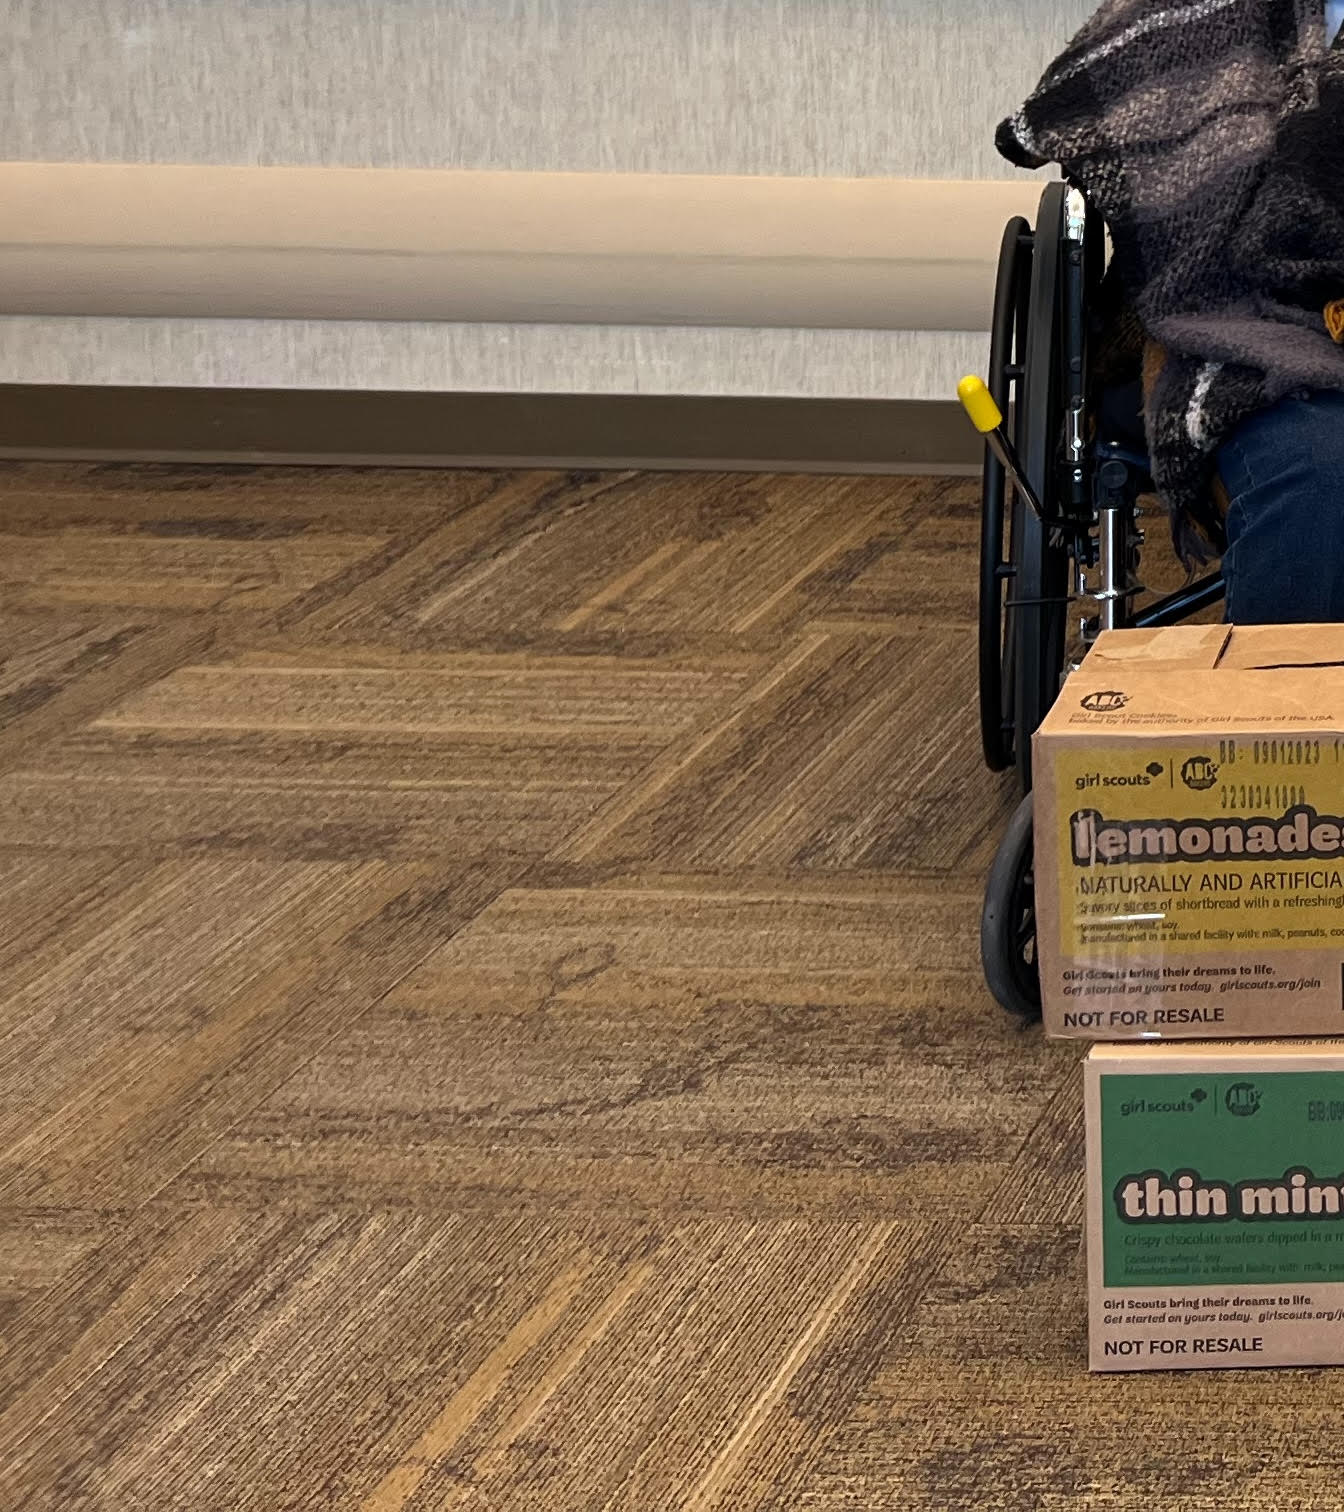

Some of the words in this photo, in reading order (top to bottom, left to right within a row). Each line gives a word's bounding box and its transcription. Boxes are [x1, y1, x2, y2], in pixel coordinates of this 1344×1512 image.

[1184, 762, 1214, 779] ABC
[1076, 773, 1099, 789] girl
[1103, 774, 1150, 786] scouts
[1077, 874, 1192, 896] NATURALLY
[1200, 874, 1243, 891] AND
[1160, 898, 1172, 911] of
[1176, 896, 1240, 910] shortbread
[1244, 895, 1269, 908] with
[1273, 897, 1280, 907] a
[1064, 1012, 1104, 1027] NOT
[1110, 1011, 1148, 1026] FOR
[1153, 1008, 1225, 1024] RESALE
[1121, 1099, 1144, 1116] girl
[1148, 1102, 1194, 1113] scouts
[1120, 1174, 1229, 1218] thin
[1104, 1299, 1125, 1310] Girl
[1128, 1300, 1166, 1309] Scouts
[1170, 1298, 1199, 1310] bring
[1202, 1297, 1229, 1307] their
[1233, 1296, 1275, 1306] dreams
[1279, 1297, 1290, 1305] to
[1293, 1295, 1313, 1305] life.
[1104, 1314, 1123, 1325] Get
[1126, 1313, 1165, 1324] started
[1168, 1315, 1181, 1323] on
[1184, 1313, 1216, 1325] yours
[1219, 1312, 1253, 1322] today.
[1104, 1341, 1143, 1356] NOT
[1150, 1340, 1187, 1354] FOR
[1193, 1338, 1263, 1352] RESALE
